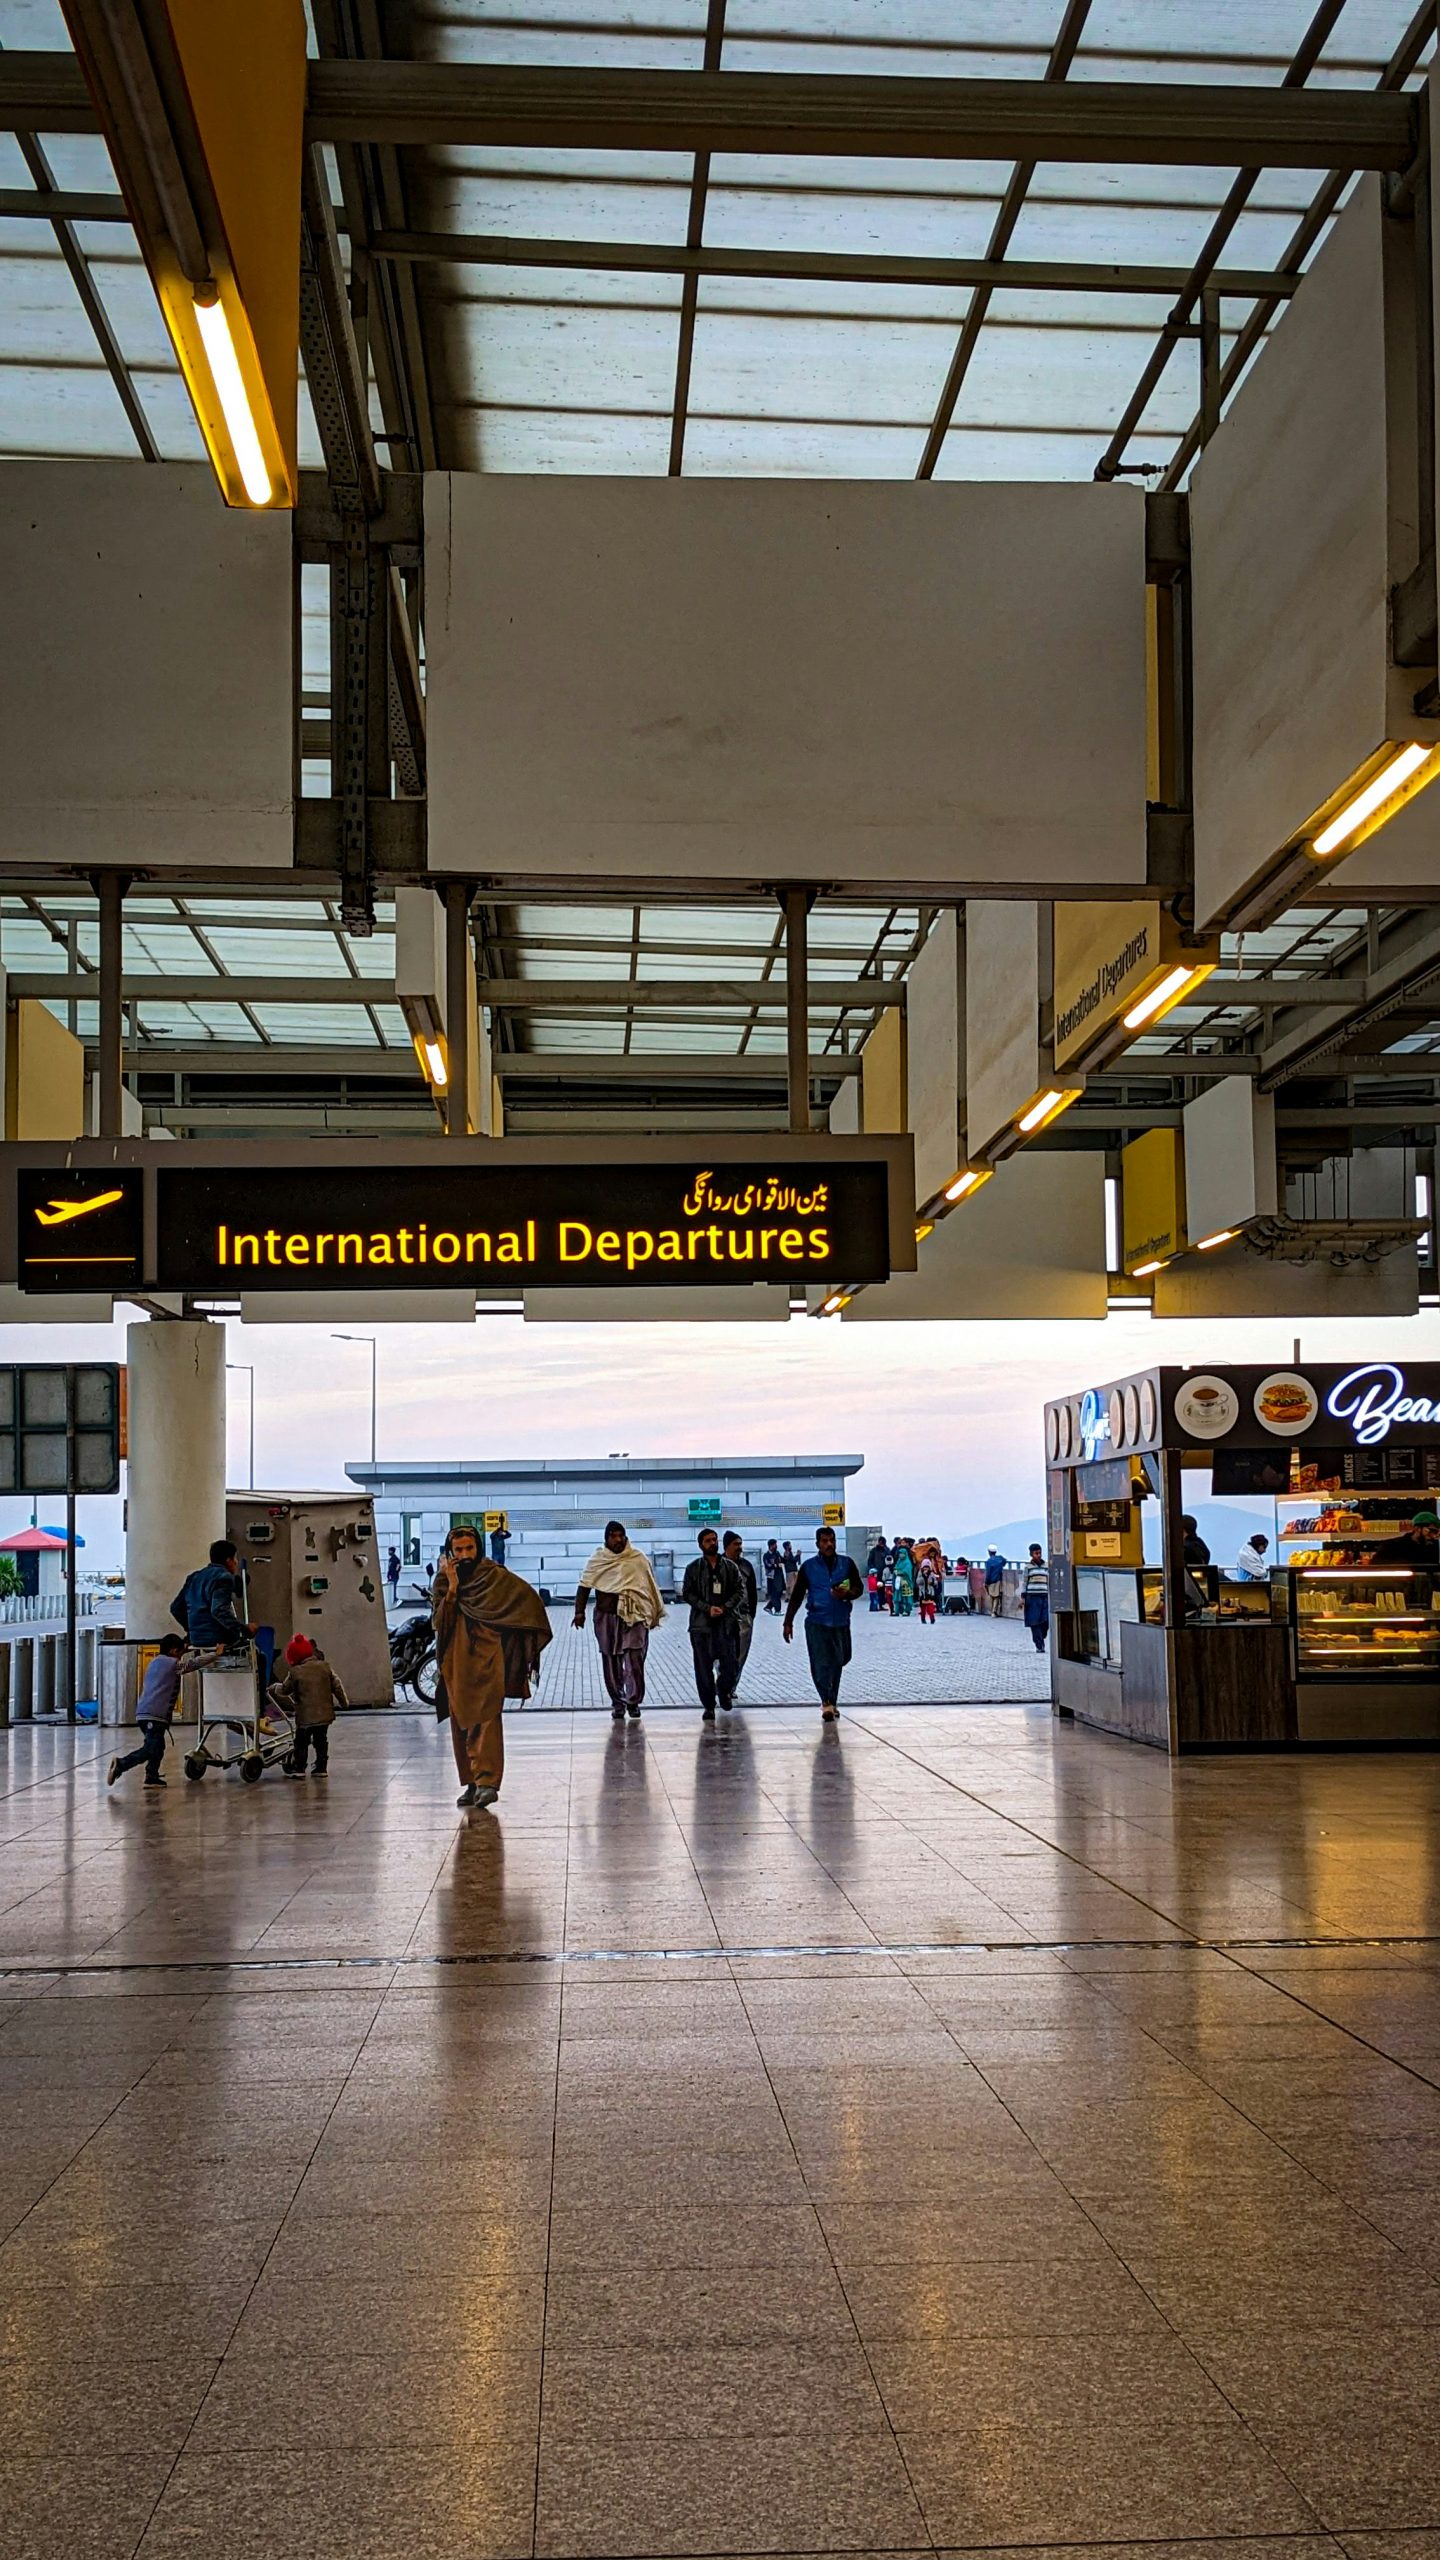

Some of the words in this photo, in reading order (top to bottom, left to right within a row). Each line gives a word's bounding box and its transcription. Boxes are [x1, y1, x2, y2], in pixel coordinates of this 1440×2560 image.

[1056, 967, 1101, 1046] International
[1101, 926, 1148, 999] Departures
[683, 1170, 733, 1216] روانگی
[796, 1183, 829, 1215] بین
[218, 1219, 536, 1266] International
[558, 1221, 831, 1271] Departures
[1343, 1453, 1354, 1484] SNACKS
